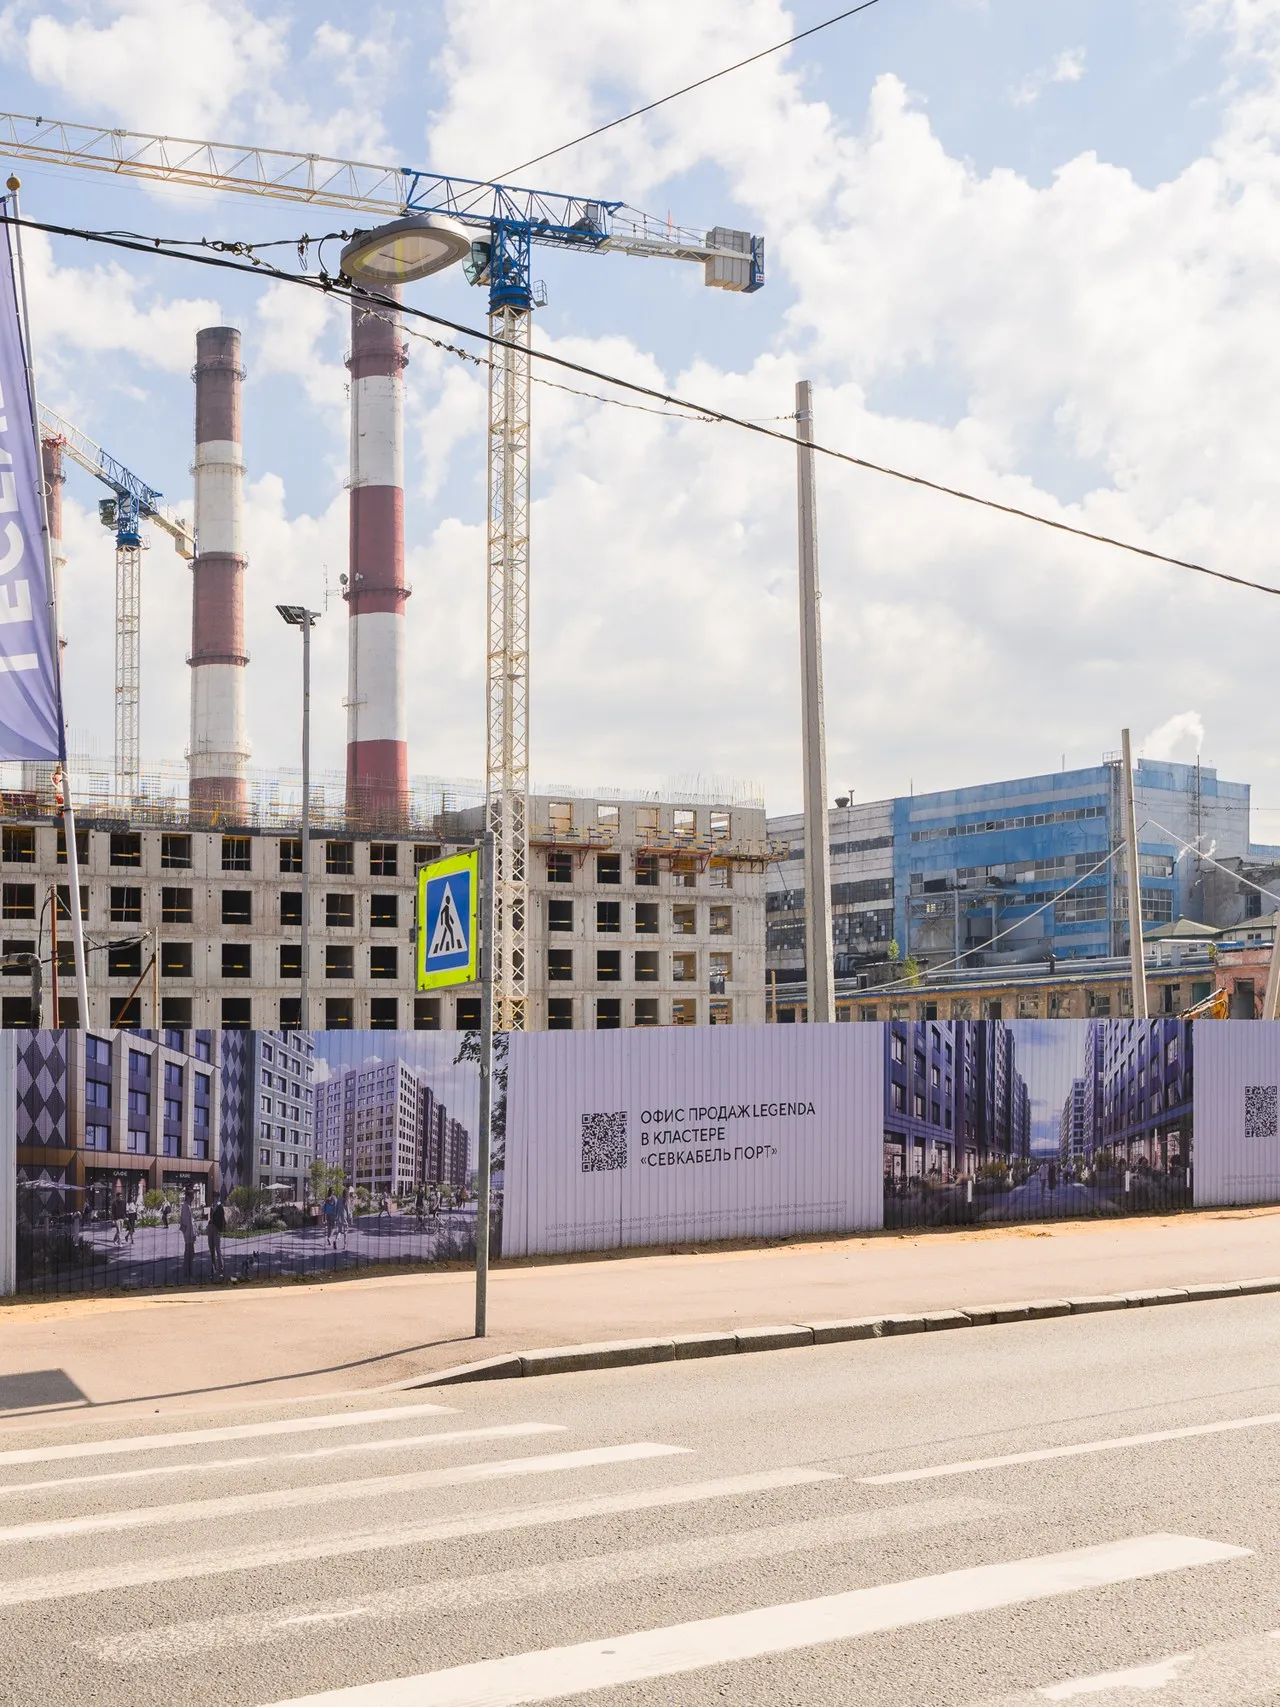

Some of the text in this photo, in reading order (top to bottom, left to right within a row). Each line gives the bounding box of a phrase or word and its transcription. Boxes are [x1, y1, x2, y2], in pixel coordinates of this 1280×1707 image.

[641, 1102, 815, 1125] ОФИС ПРОДАЖ LEGENDA
[642, 1127, 725, 1146] В КЛАСТЕРЕ
[641, 1145, 778, 1167] «СЕВКАБЕЛЬ ПОРТ»
